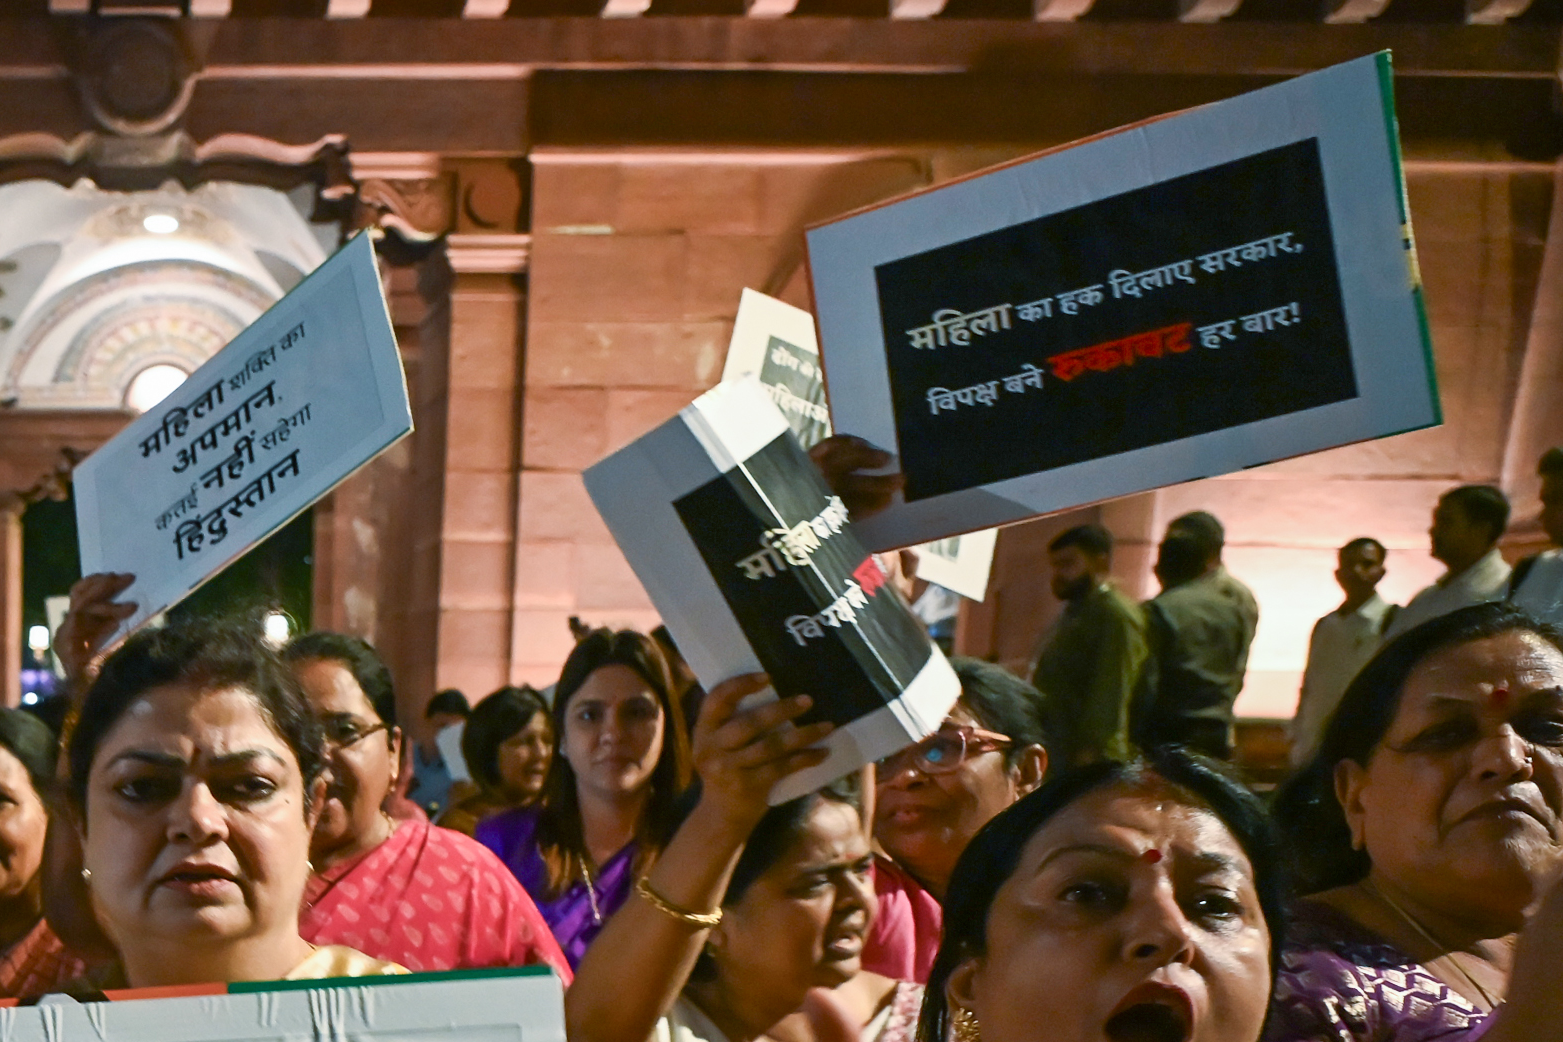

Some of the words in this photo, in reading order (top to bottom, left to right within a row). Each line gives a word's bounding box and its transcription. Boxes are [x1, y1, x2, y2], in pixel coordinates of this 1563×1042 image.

[906, 303, 1014, 350] महिला
[1017, 297, 1053, 323] का
[1056, 284, 1104, 315] हक
[1109, 259, 1196, 299] दिलाए
[1198, 232, 1304, 273] सरकार,
[139, 378, 225, 458] महिला
[228, 345, 277, 391] शक्ति
[279, 321, 305, 351] का
[927, 380, 999, 415] विपक्ष
[1003, 363, 1043, 394] बने
[1047, 322, 1192, 382] रुकावट
[1196, 320, 1236, 349] हर
[1240, 302, 1301, 334] बार!
[155, 482, 198, 530] कतई
[199, 430, 256, 488] नहीं
[260, 403, 311, 450] सहेगा
[173, 449, 300, 560] हिंदुस्तान
